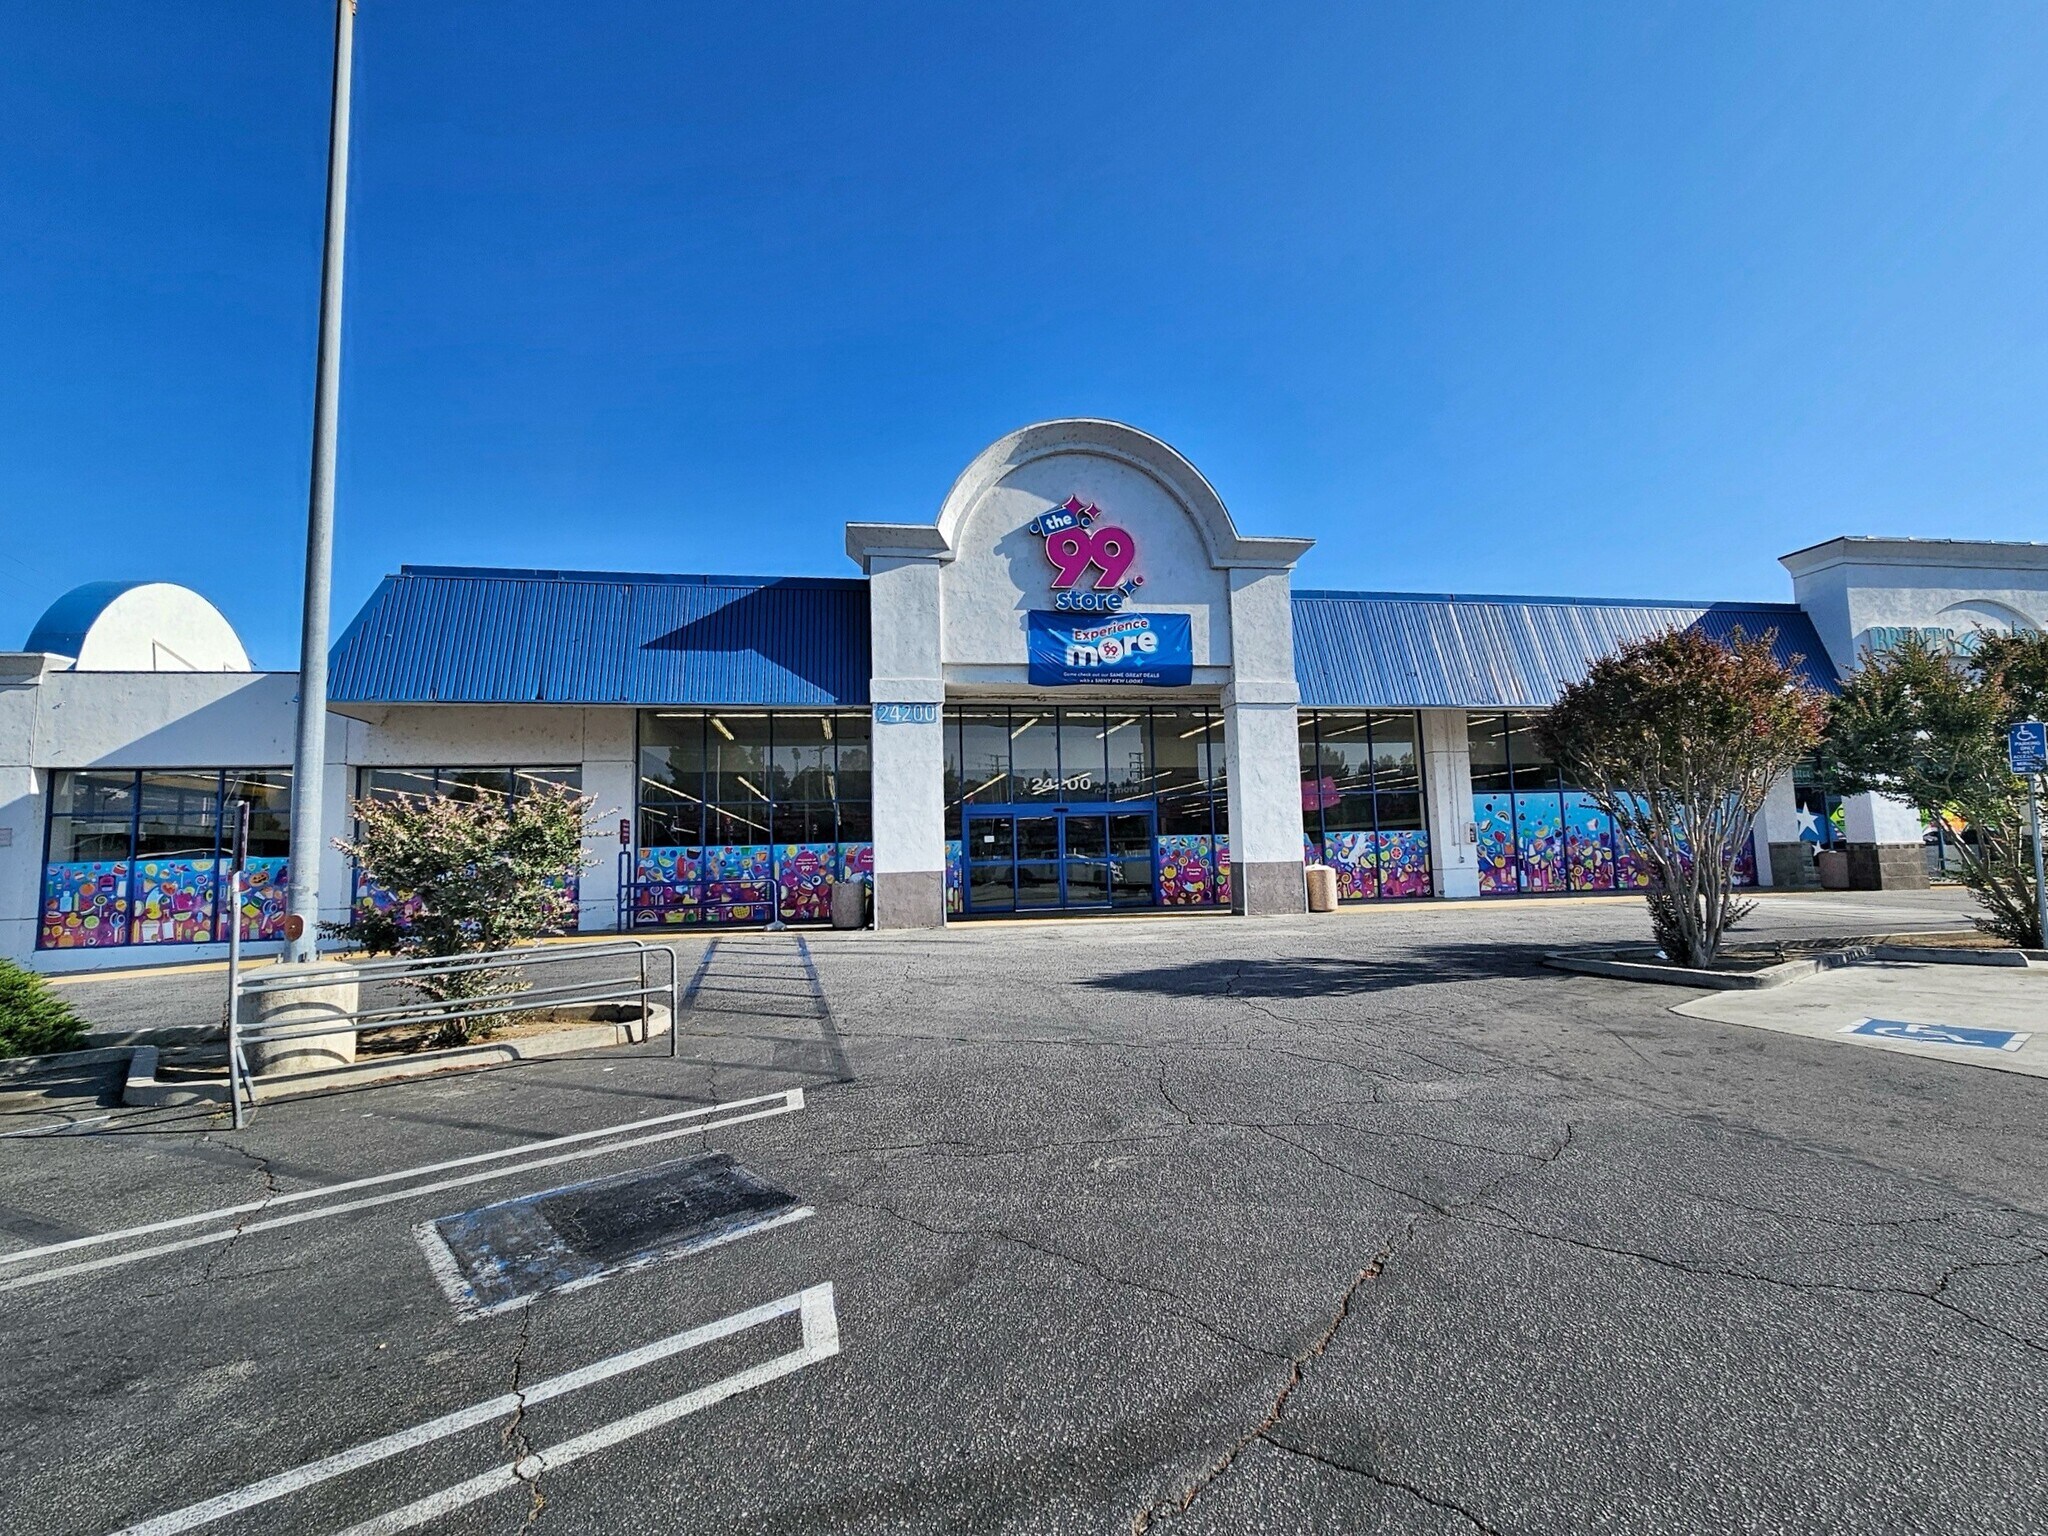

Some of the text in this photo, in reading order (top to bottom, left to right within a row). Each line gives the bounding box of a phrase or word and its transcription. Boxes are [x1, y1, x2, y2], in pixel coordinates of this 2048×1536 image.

[1045, 514, 1073, 530] the
[1045, 526, 1135, 590] 99
[1055, 589, 1123, 612] store
[1073, 619, 1149, 642] Experience
[878, 704, 935, 722] 24200
